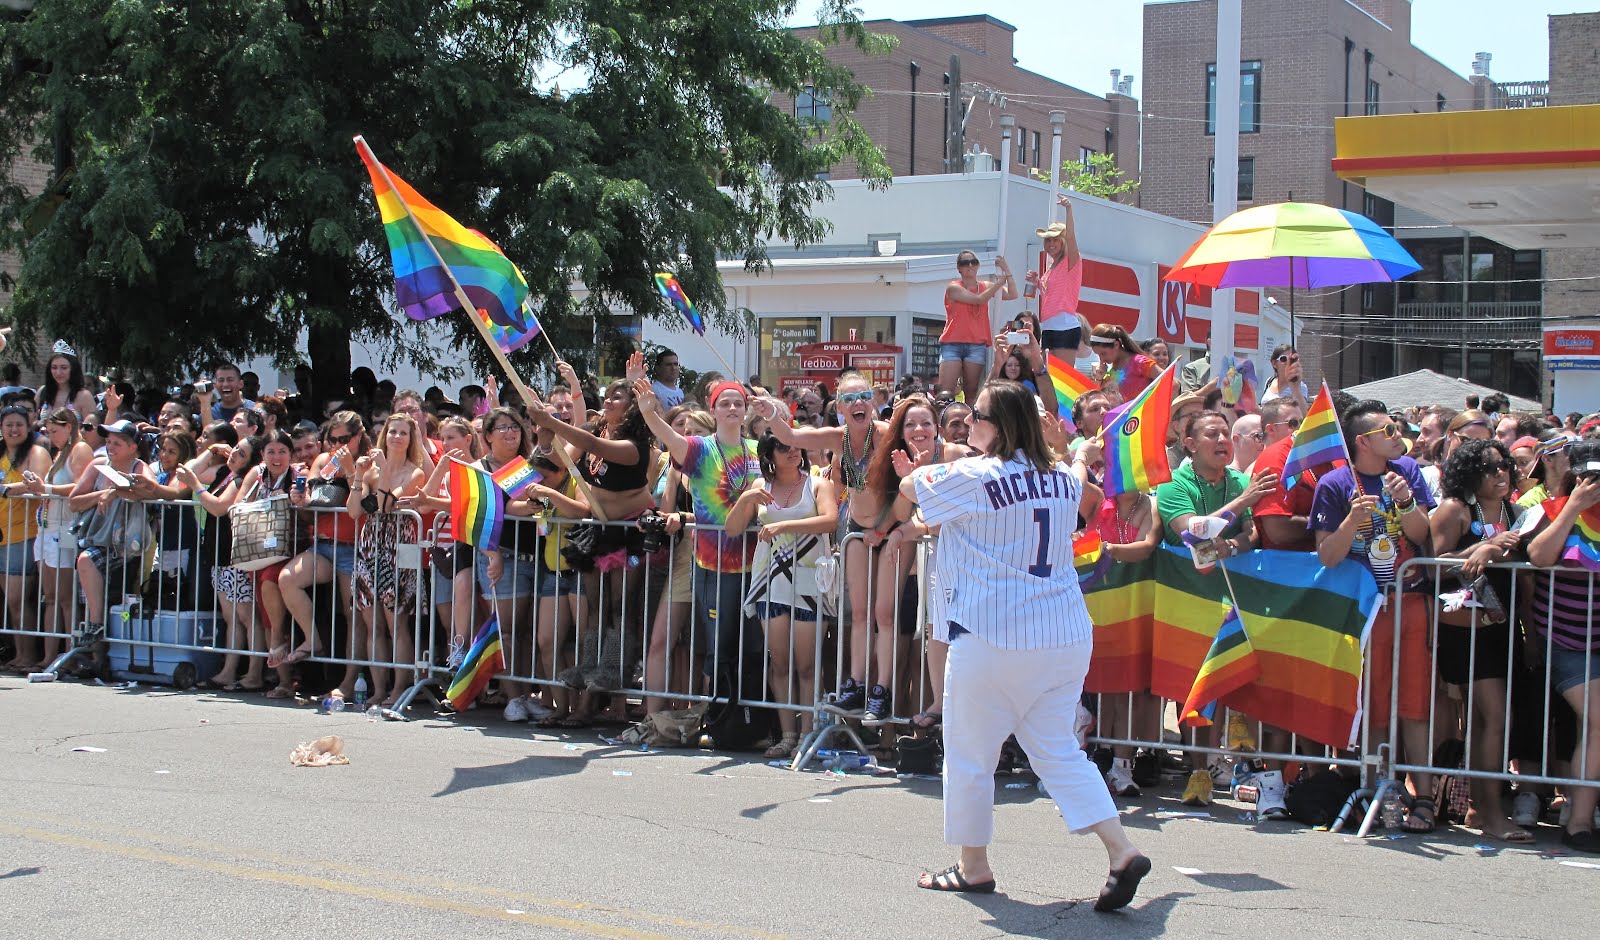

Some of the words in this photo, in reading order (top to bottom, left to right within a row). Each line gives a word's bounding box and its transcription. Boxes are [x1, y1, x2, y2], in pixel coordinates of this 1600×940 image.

[782, 329, 802, 338] Gallon
[802, 329, 817, 337] Milk
[803, 358, 838, 368] redbox
[502, 465, 534, 490] ISRAEL
[1028, 508, 1053, 578] 1
